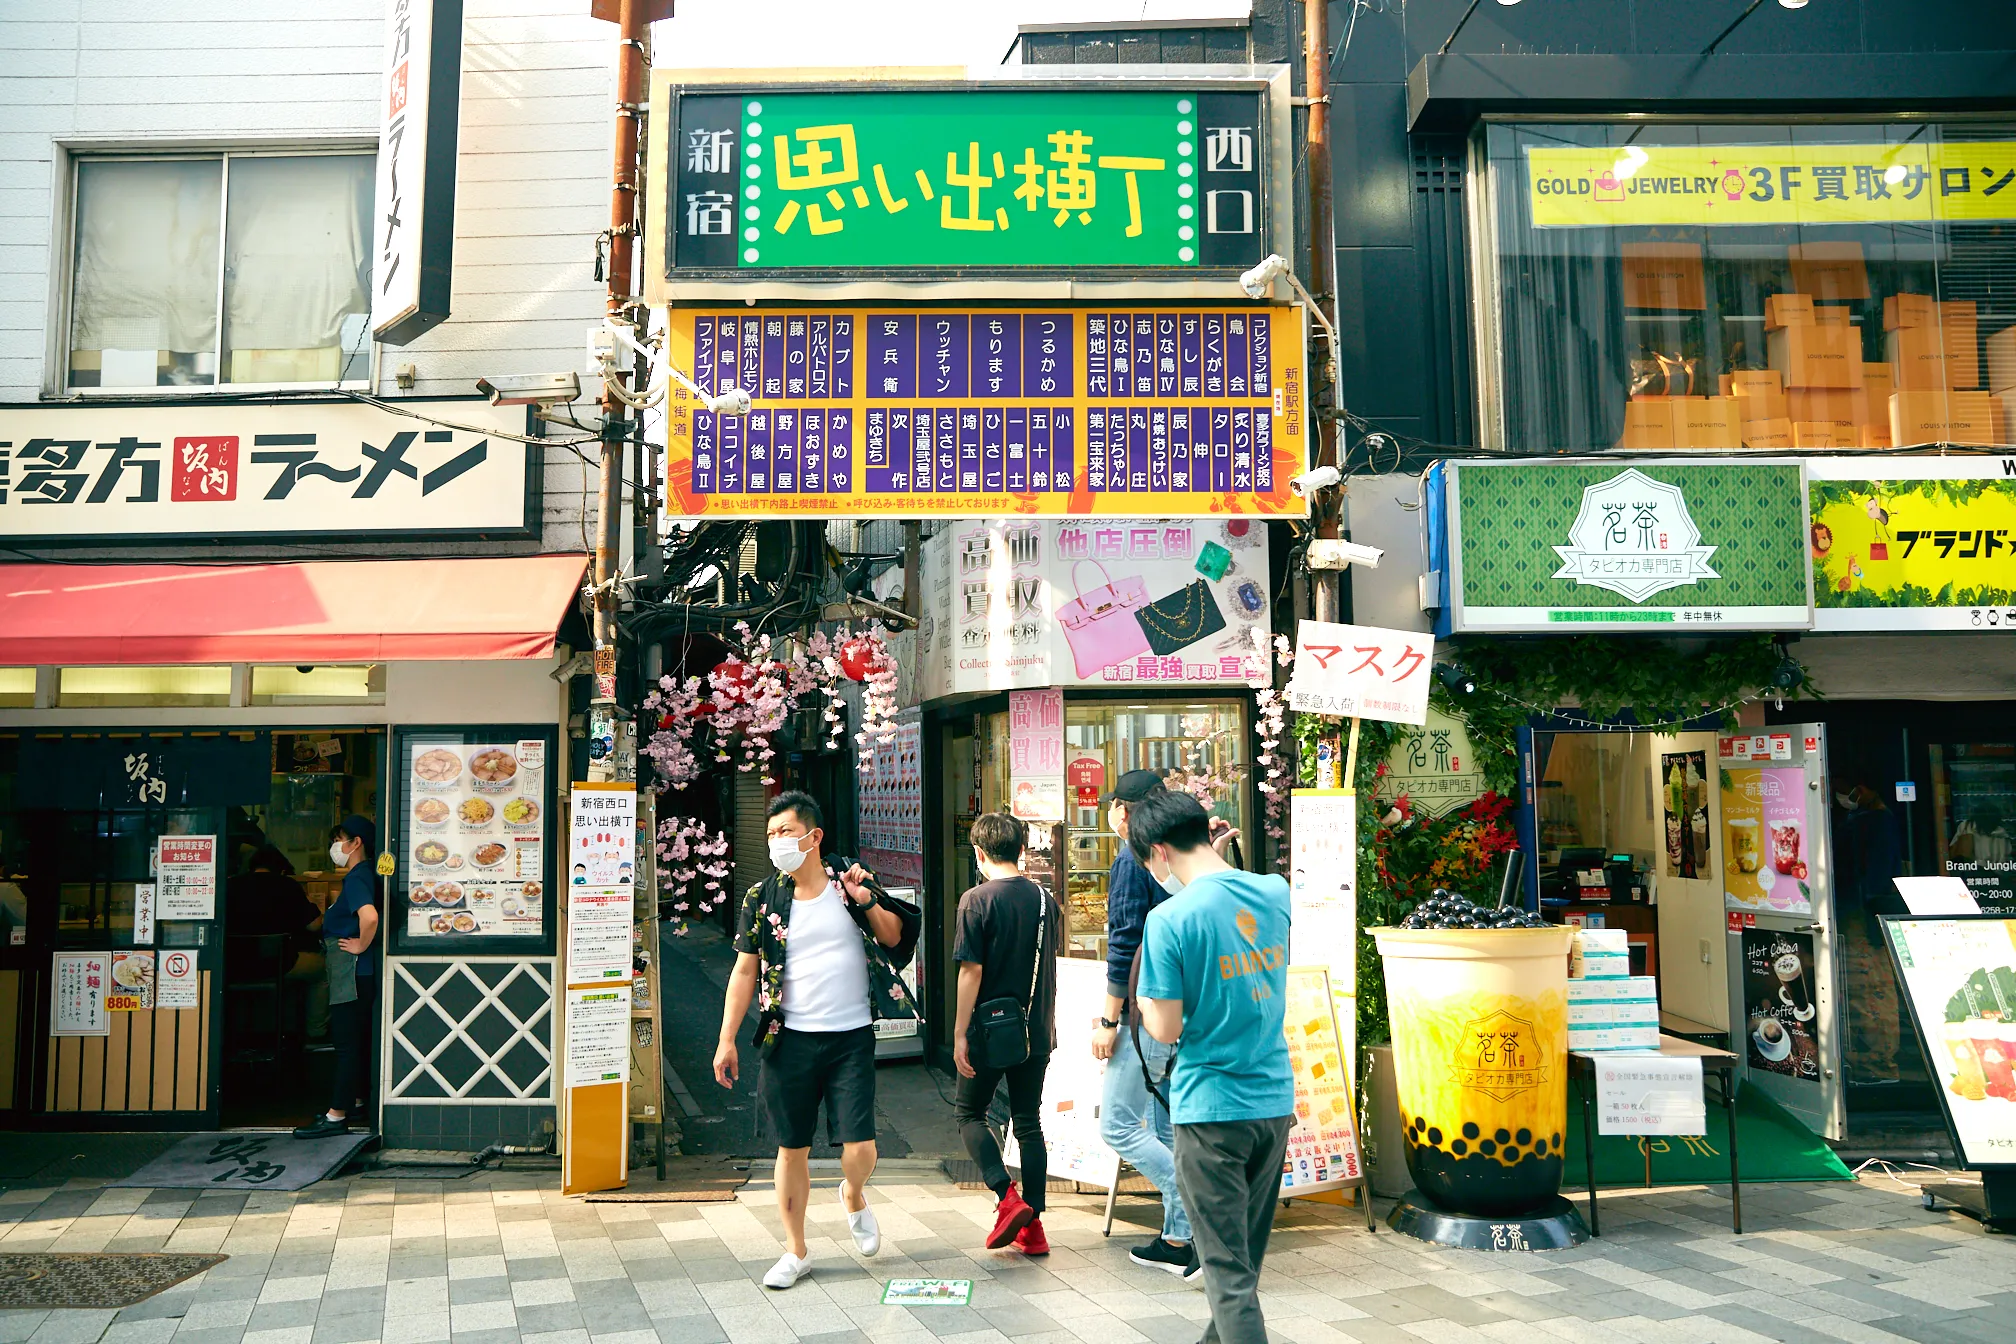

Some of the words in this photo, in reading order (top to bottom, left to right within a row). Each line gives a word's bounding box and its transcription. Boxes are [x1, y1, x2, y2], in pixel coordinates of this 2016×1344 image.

[686, 127, 734, 236] 新宿
[774, 123, 1165, 238] 思い出横丁
[1206, 125, 1253, 235] 西口
[1536, 177, 1590, 196] GOLD
[1627, 176, 1719, 196] JEWELRY
[743, 321, 759, 393] 情熱ホルモン
[765, 321, 782, 393] 朝起
[788, 321, 805, 394] 藤の家
[812, 321, 827, 394] アルバトロス
[835, 321, 850, 393] カブト
[883, 320, 899, 393] 安兵衛
[936, 320, 950, 392] ウッチャン
[988, 320, 1003, 393] もります
[1040, 320, 1056, 392] つるかめ
[1089, 318, 1106, 392] 築地三代
[1136, 319, 1152, 392] 志乃笛
[1183, 319, 1198, 392] すし辰
[1206, 319, 1222, 392] らくがき
[1253, 319, 1267, 393] コレクション新宿
[868, 412, 884, 463] まゆきち
[1285, 367, 1299, 436] 新宿駅方面
[1765, 433, 1788, 441] VUITTON
[182, 441, 229, 497] 坂内
[724, 415, 739, 489] ココイチ
[750, 415, 767, 488] 越後屋
[777, 415, 793, 489] 野方屋
[804, 415, 821, 488] ほおずき
[832, 414, 848, 488] かめや
[891, 414, 908, 489] 次作
[915, 414, 931, 488] 埼玉屋弐号店
[939, 414, 953, 488] ささもと
[962, 414, 977, 488] 埼玉屋
[986, 414, 1001, 488] ひさご
[1009, 418, 1024, 488] 一富士
[1032, 414, 1048, 488] 五十鈴
[1055, 414, 1071, 488] 小松
[1089, 413, 1105, 487] 第一宝来家
[1110, 413, 1125, 487] たっちゃん
[1131, 413, 1146, 488] 丸庄
[1152, 412, 1166, 487] 炭焼おっけい
[1172, 414, 1188, 488] 辰乃家
[1193, 442, 1209, 459] 伸
[1214, 413, 1228, 487] タロー
[1234, 413, 1250, 488] 炙り清水
[1058, 527, 1192, 558] 他店圧倒
[1601, 501, 1660, 551] 茗茶
[1589, 558, 1682, 573] タピオカ専門店
[1683, 611, 1723, 622] 年中無休
[596, 650, 613, 660] HOT
[596, 660, 613, 670] FIRE
[1303, 642, 1426, 684] マスク
[1011, 692, 1061, 729] 高価
[1295, 692, 1354, 713] 緊急入荷
[124, 752, 167, 804] 坂内
[1011, 737, 1061, 771] 買取
[1396, 778, 1471, 794] タピオカ専門店
[1406, 729, 1453, 775] 茗茶
[575, 815, 633, 827] 思い出横丁
[581, 797, 627, 809] 新宿西口
[1745, 782, 1780, 797] 新製品
[1768, 807, 1800, 815] イチゴミルク
[162, 840, 212, 851] 営業時間変更の
[172, 852, 201, 861] お知らせ
[1946, 860, 1978, 871] Brand
[1966, 877, 1999, 886] 営業時間
[139, 890, 152, 939] 営業中
[1747, 943, 1768, 960] Hot
[1770, 942, 1798, 957] Cocoa
[107, 996, 138, 1009] 880円
[1750, 1006, 1768, 1019] Hot
[1465, 1072, 1533, 1085] タピオカ専門店
[1476, 1032, 1520, 1068] 茗茶
